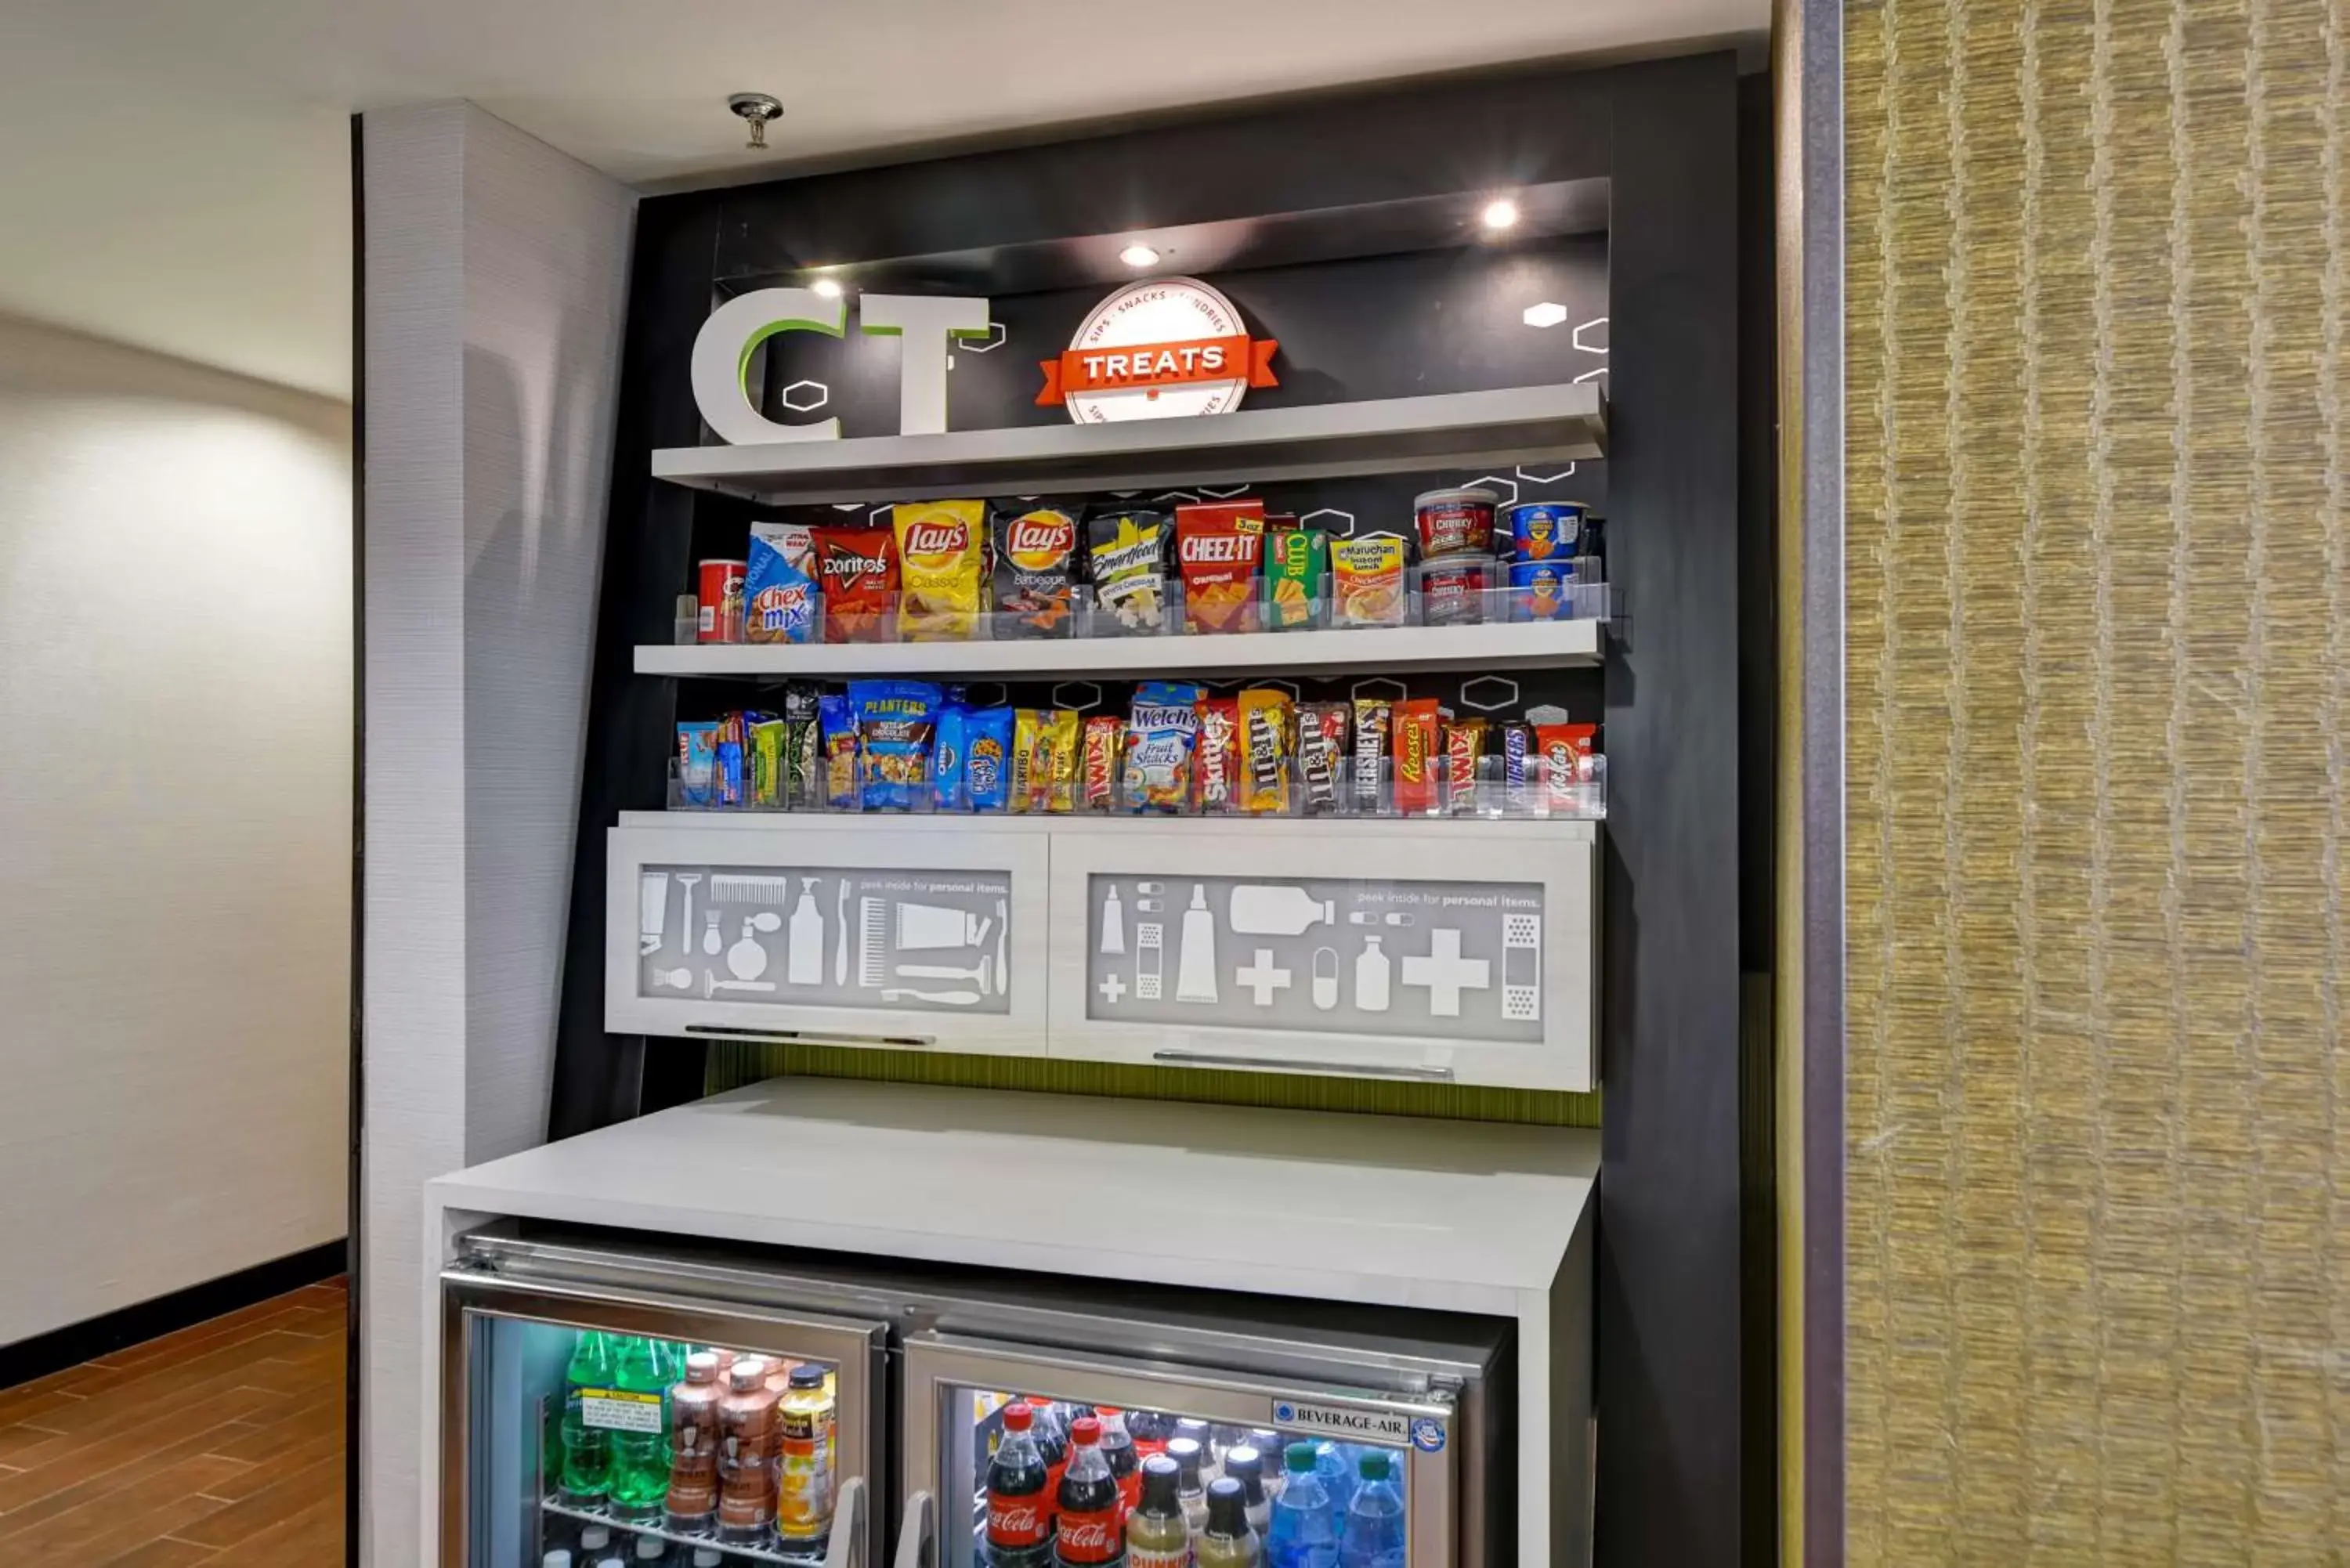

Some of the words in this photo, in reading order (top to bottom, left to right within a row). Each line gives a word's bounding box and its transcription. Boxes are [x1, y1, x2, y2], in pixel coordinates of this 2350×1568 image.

[1090, 318, 1111, 344] SIPS
[1118, 290, 1166, 313] SNACKS
[1083, 346, 1224, 379] TREATS
[906, 520, 965, 555] Lay's
[1010, 522, 1070, 553] Lay's
[824, 558, 887, 574] Doritos
[759, 582, 811, 610] Chex
[865, 699, 927, 715] PLANTERS
[1135, 708, 1198, 728] Welch's
[1144, 742, 1173, 753] Fruit
[1134, 753, 1179, 764] Snacks
[929, 882, 974, 894] personal
[976, 883, 1008, 894] items.
[1388, 893, 1418, 903] inside
[1423, 894, 1441, 904] for
[1442, 894, 1497, 907] personal
[1501, 895, 1541, 908] items.
